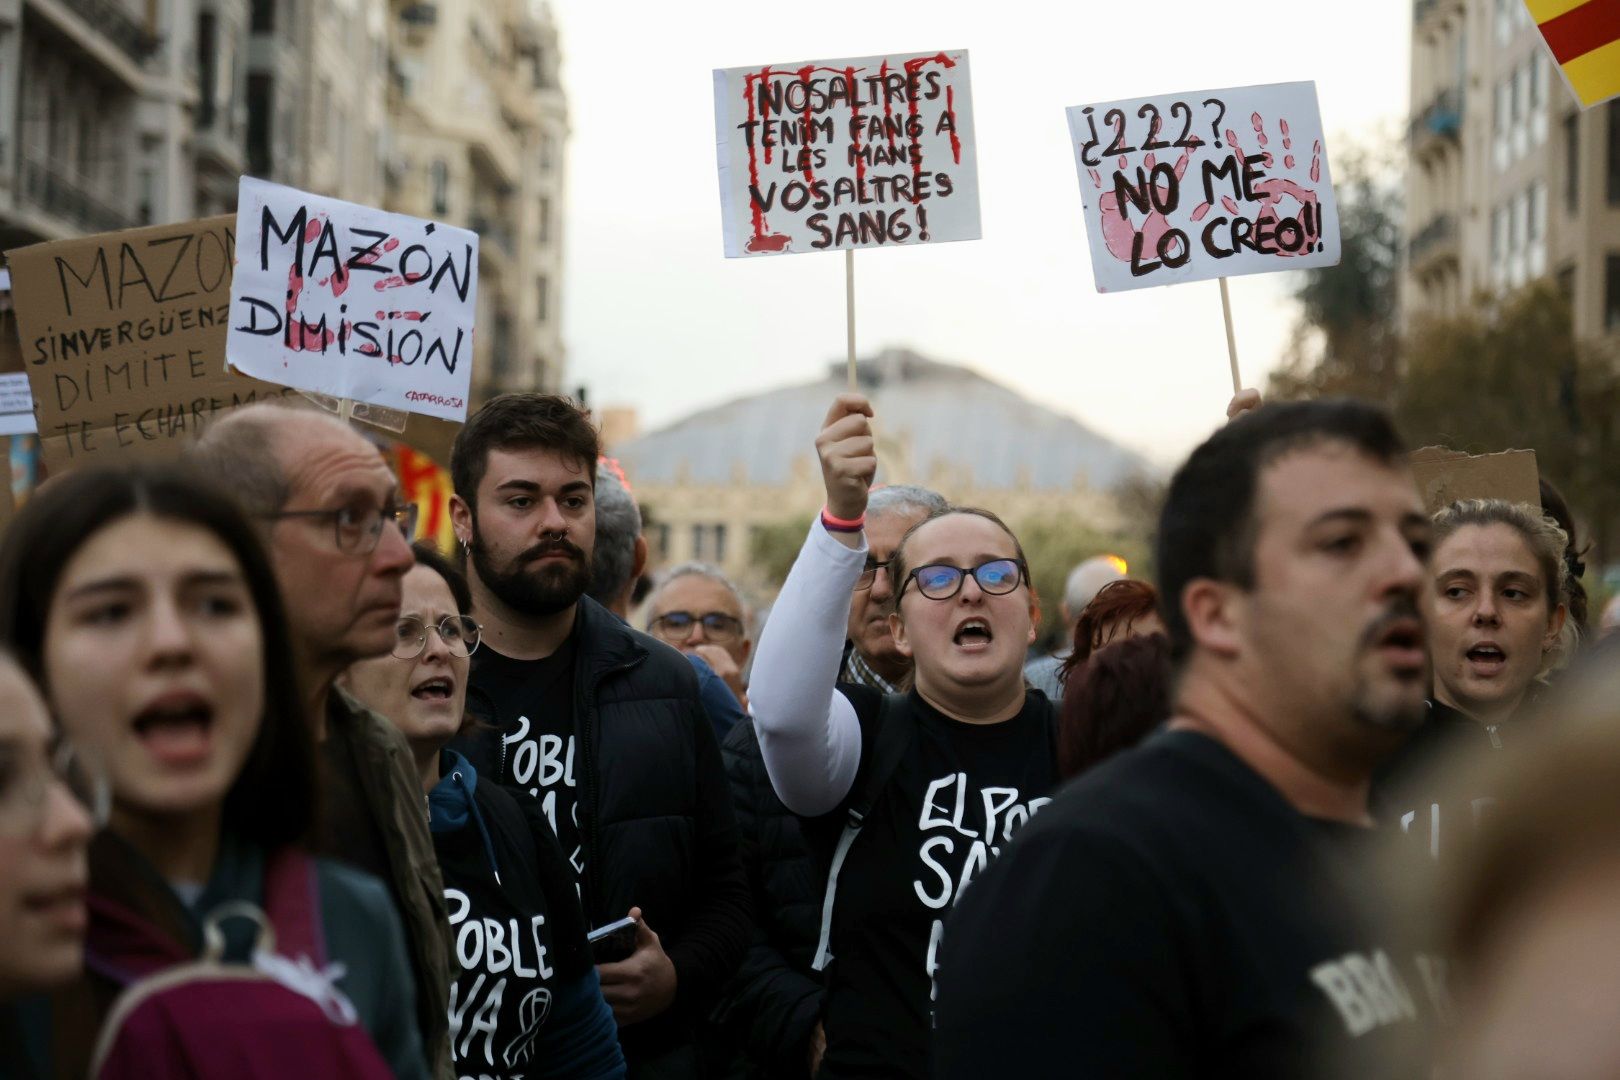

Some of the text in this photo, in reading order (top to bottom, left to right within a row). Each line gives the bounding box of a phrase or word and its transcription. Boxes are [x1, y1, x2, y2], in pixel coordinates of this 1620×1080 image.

[757, 71, 941, 116] NOSALTRES
[737, 110, 955, 147] TENIM FANG A
[782, 143, 923, 173] LES MANS
[749, 171, 954, 213] VOSALTRES
[1113, 153, 1271, 221] NO ME
[806, 204, 931, 249] SANG!
[1130, 200, 1324, 277] LO CREO!!
[260, 204, 473, 303] MAZÓN
[235, 295, 464, 374] DIMISIÓN
[55, 350, 206, 411] DIMITE
[55, 421, 97, 457] TE
[919, 772, 979, 838] EL
